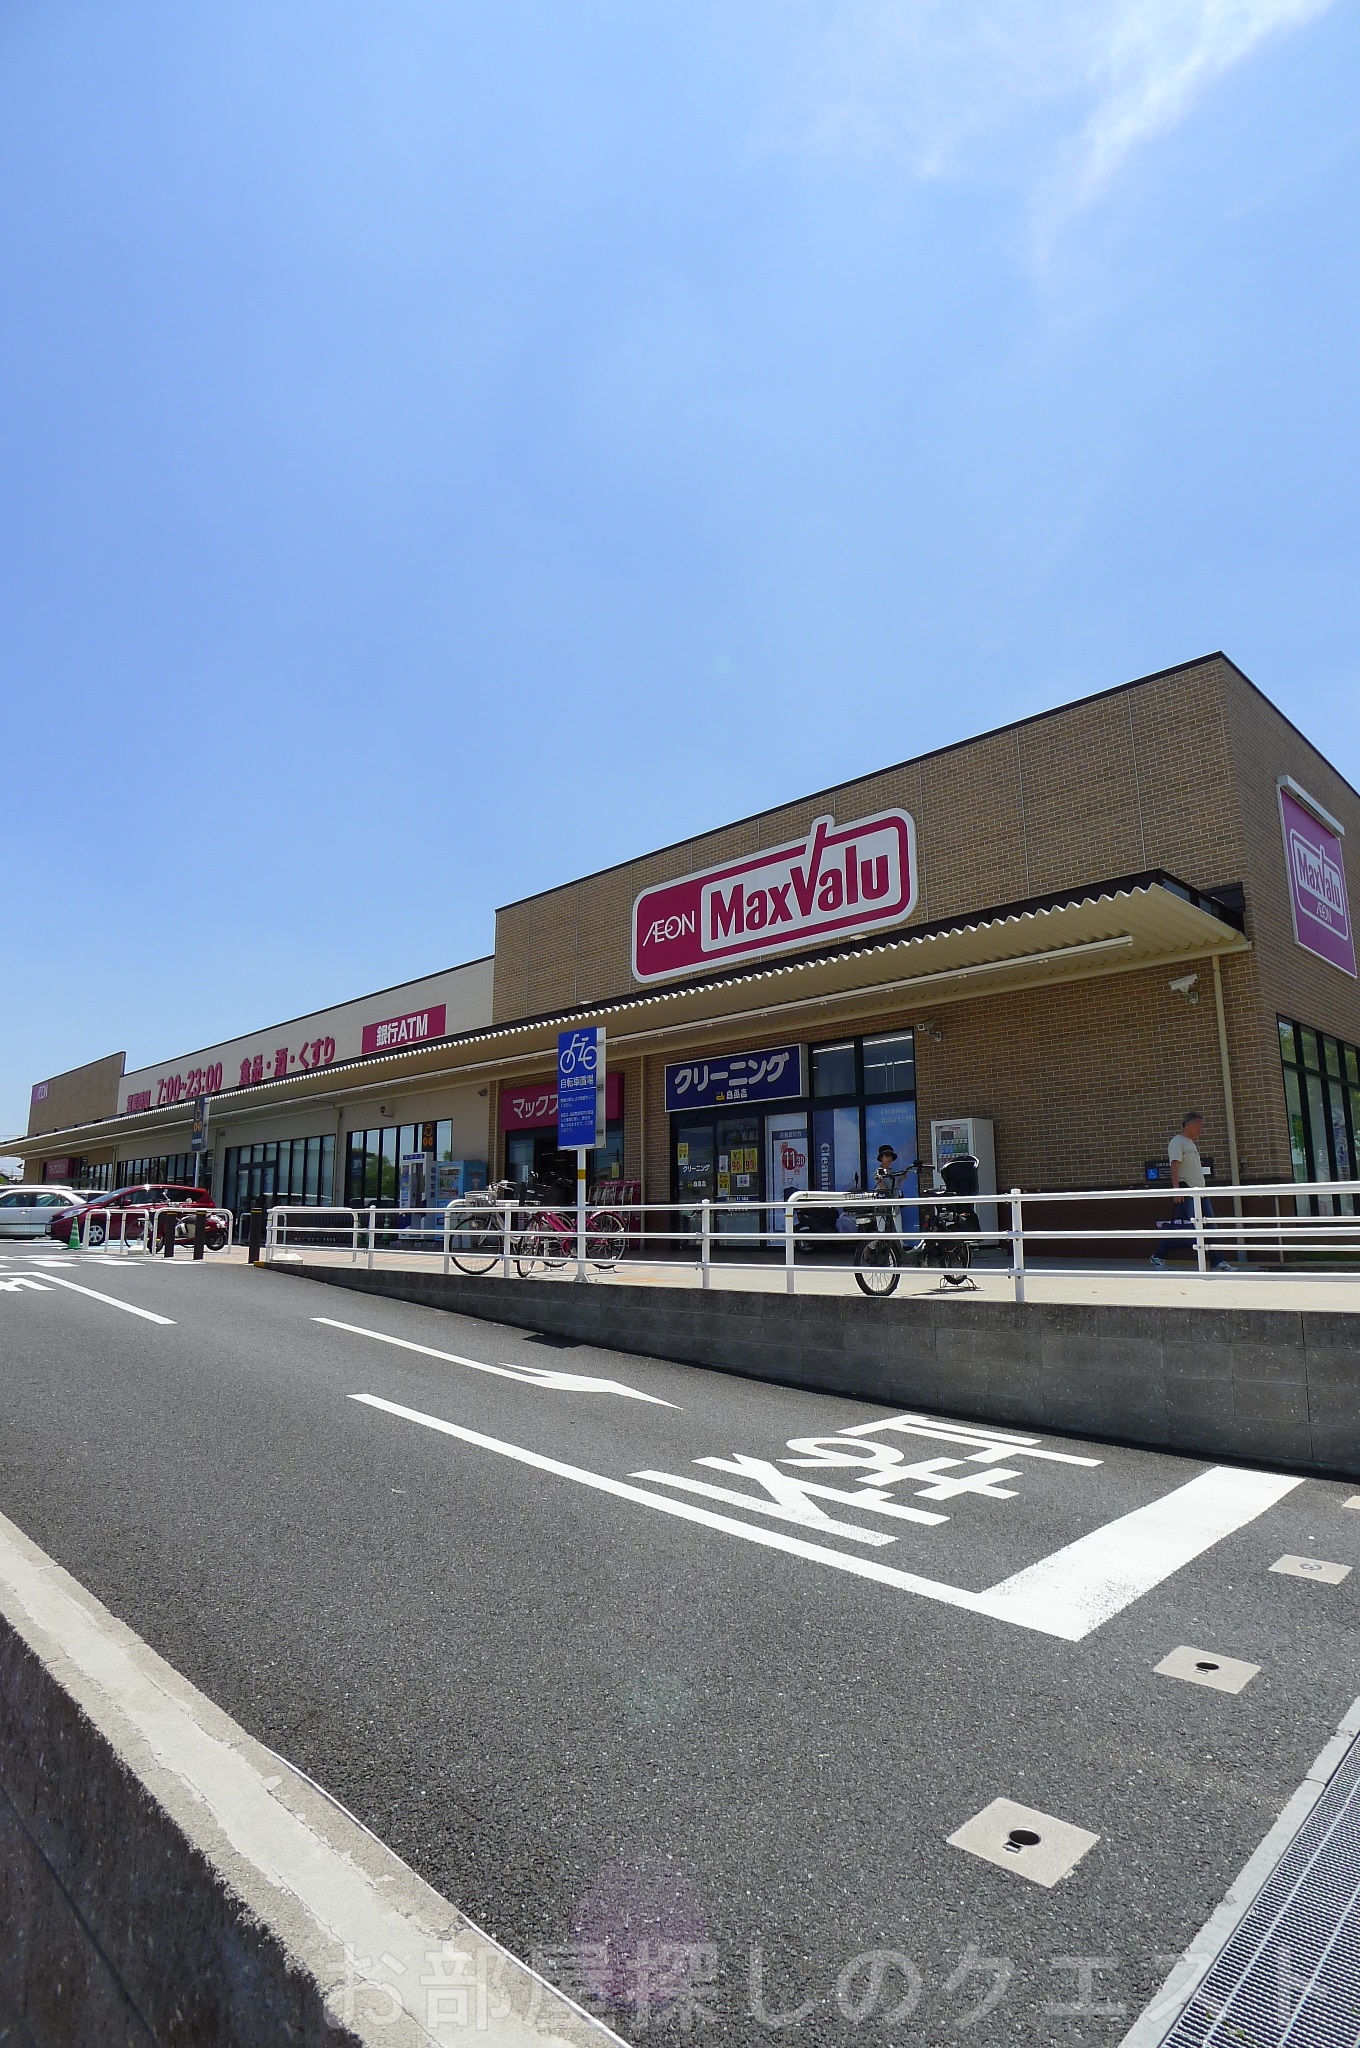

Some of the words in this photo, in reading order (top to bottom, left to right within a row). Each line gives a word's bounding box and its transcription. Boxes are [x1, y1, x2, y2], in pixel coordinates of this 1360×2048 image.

[711, 824, 889, 941] MaxValu
[1297, 848, 1340, 907] MaxValu
[376, 1013, 428, 1046] 銀行ATM
[674, 1051, 790, 1095] クリーニング
[627, 1414, 1102, 1546] 止まれ
